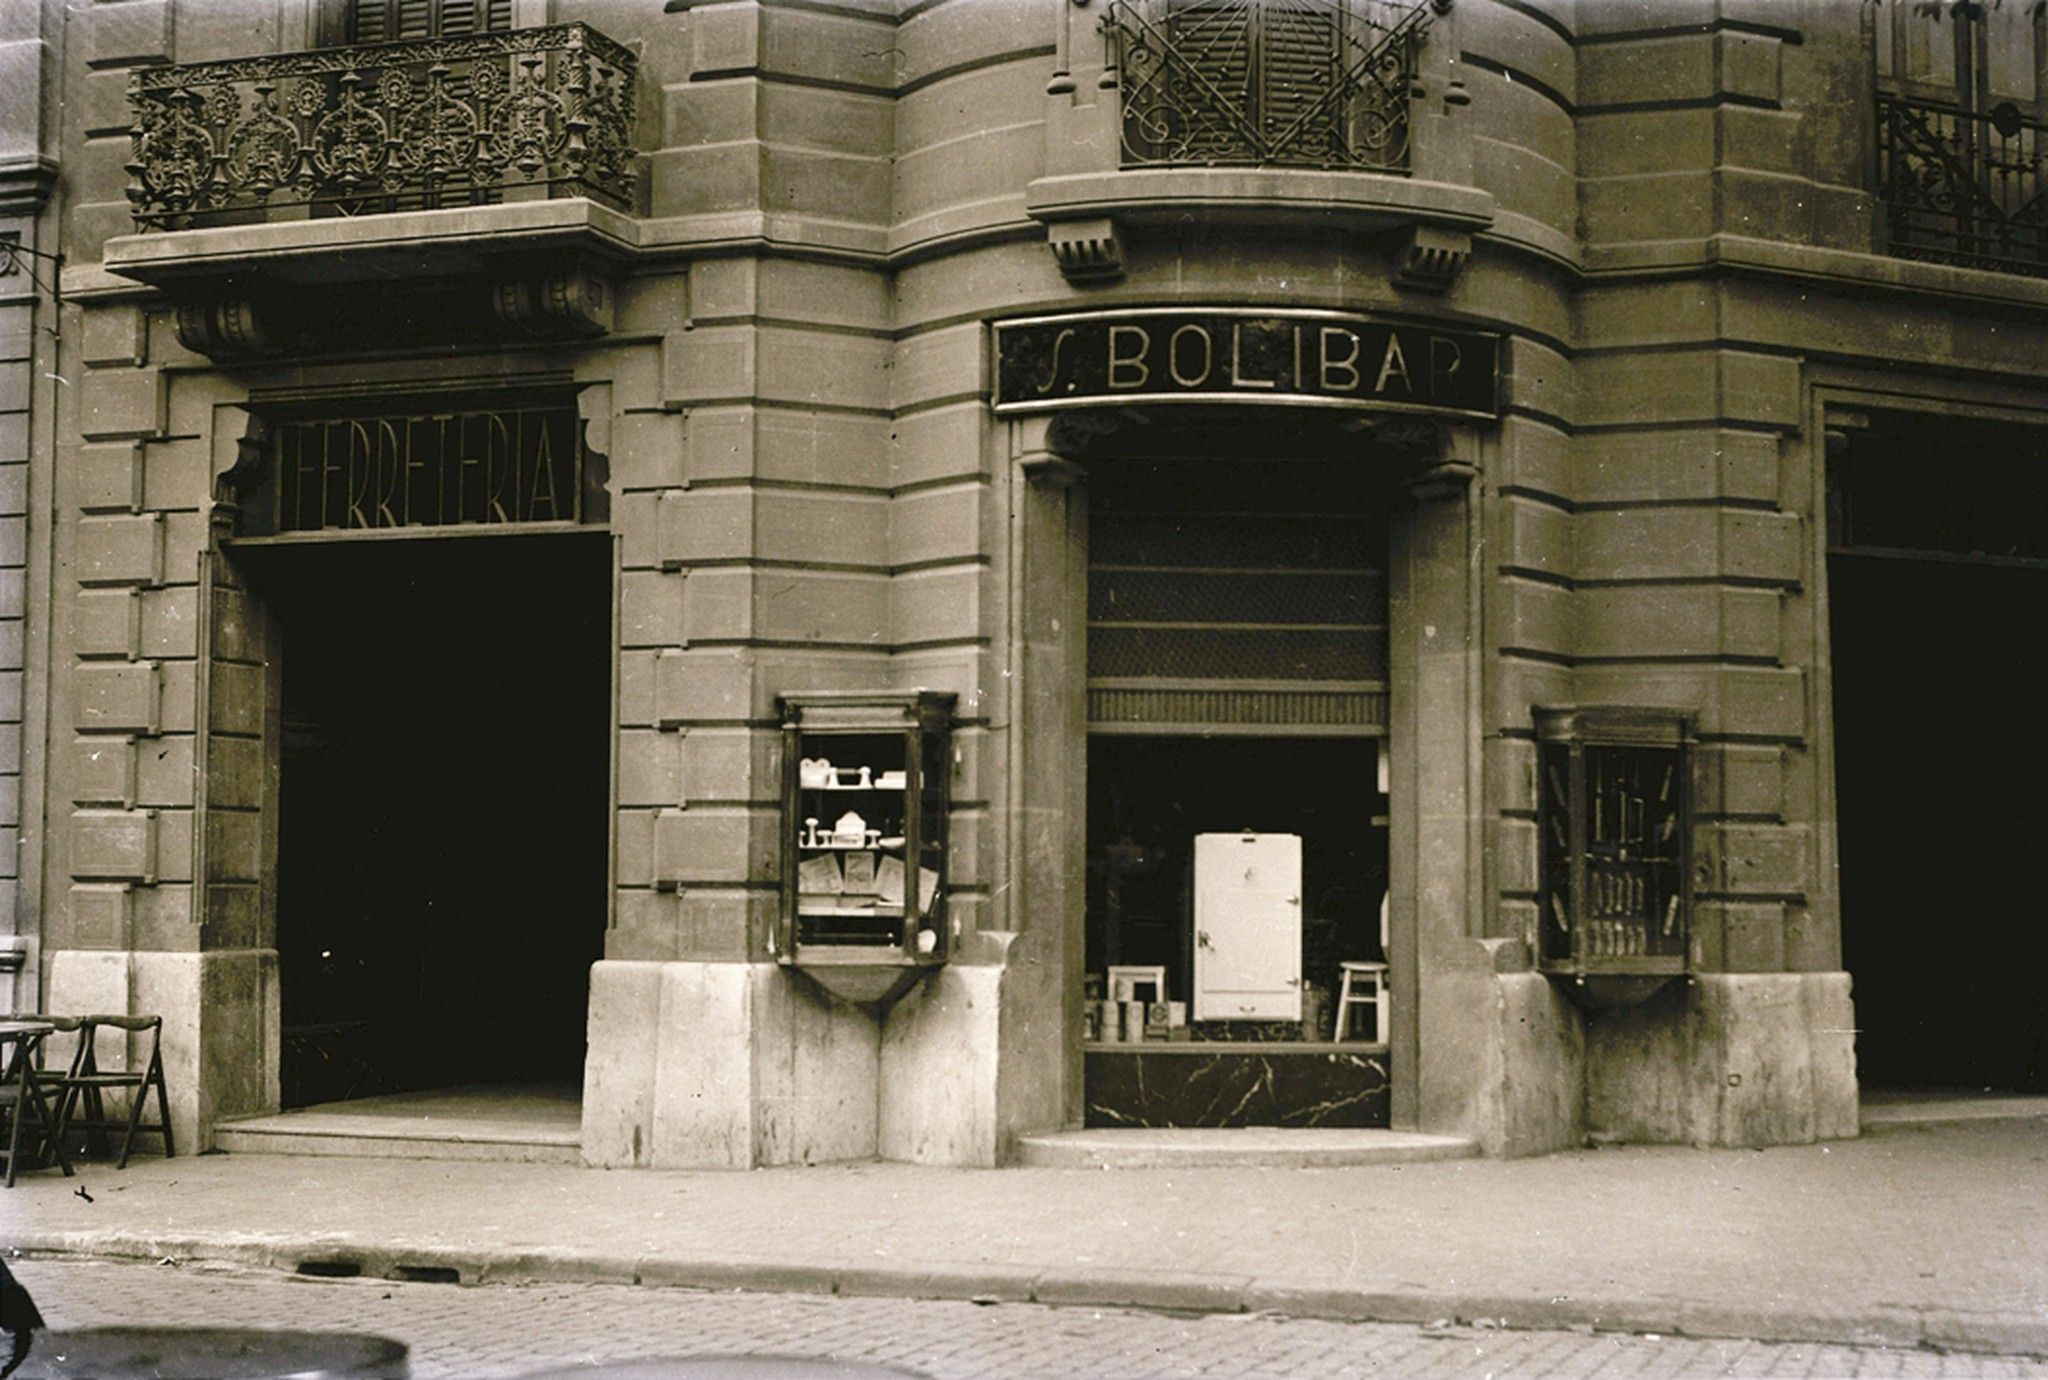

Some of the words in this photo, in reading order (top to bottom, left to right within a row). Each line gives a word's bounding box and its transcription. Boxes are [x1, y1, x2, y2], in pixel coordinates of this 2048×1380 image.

[1037, 328, 1077, 395] S.
[1108, 323, 1461, 397] BOLIBAR
[295, 411, 558, 530] FERRETERIA
